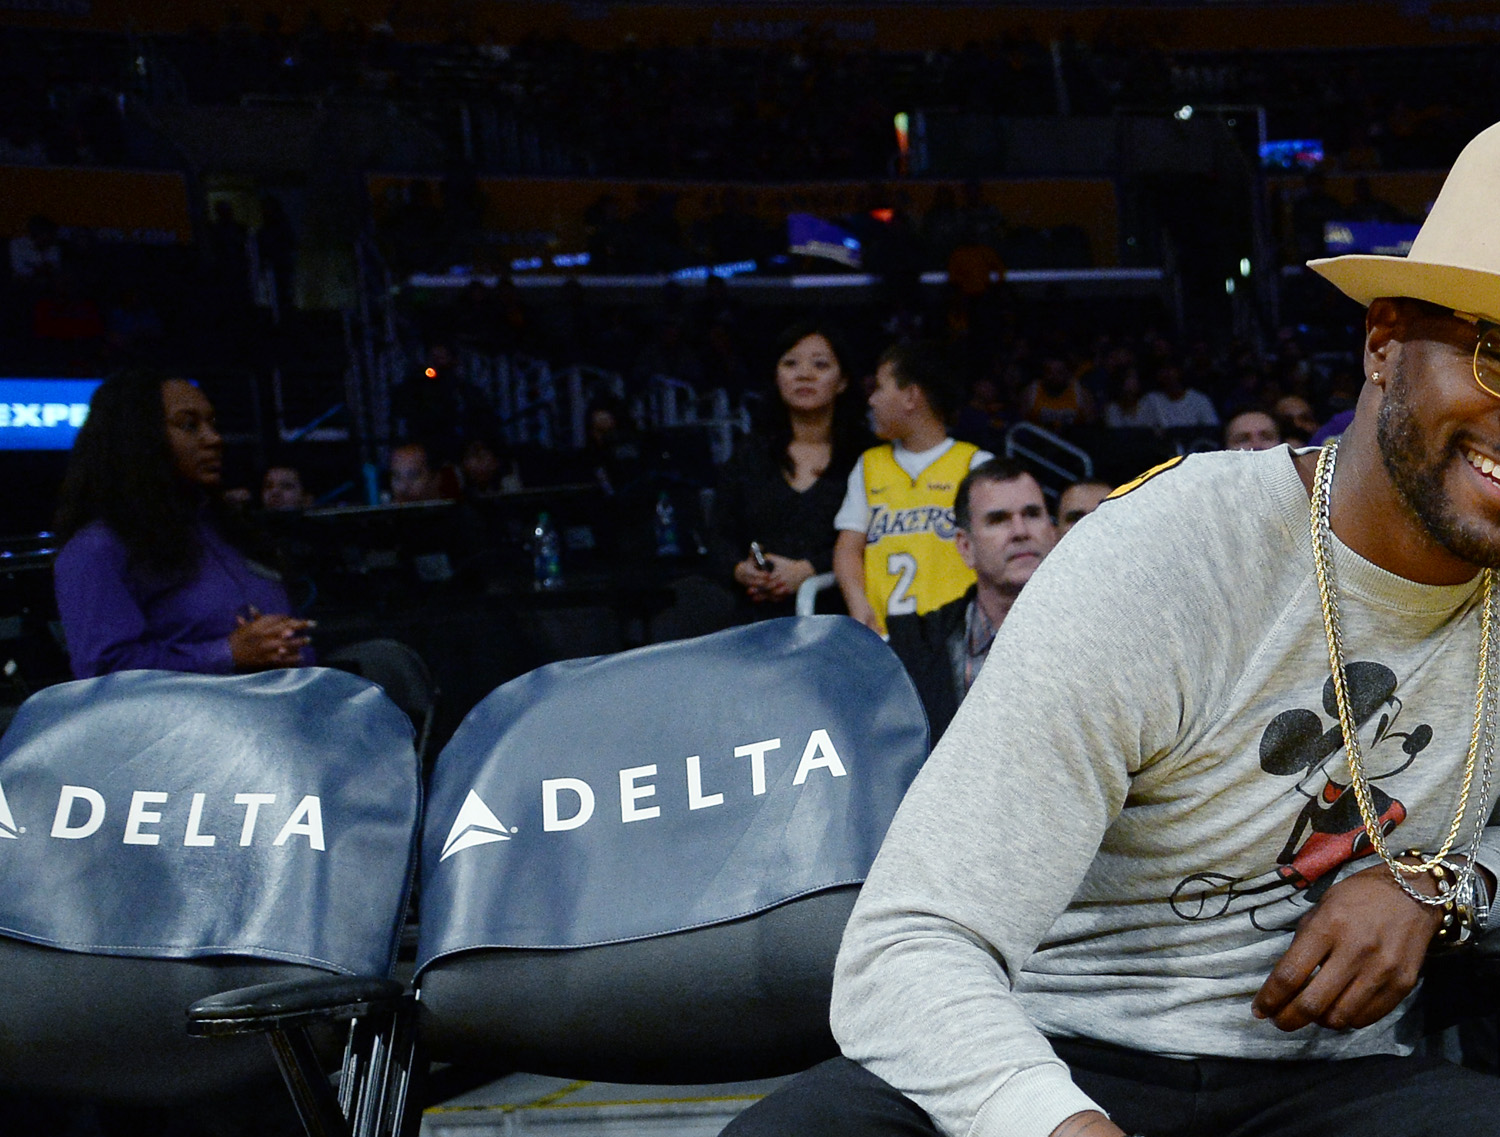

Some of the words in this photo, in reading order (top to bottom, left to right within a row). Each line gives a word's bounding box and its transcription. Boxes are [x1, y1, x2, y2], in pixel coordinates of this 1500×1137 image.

[866, 504, 957, 545] LAKERS
[887, 552, 918, 616] 2
[543, 728, 848, 832] DELTA
[51, 785, 326, 852] DELTA
